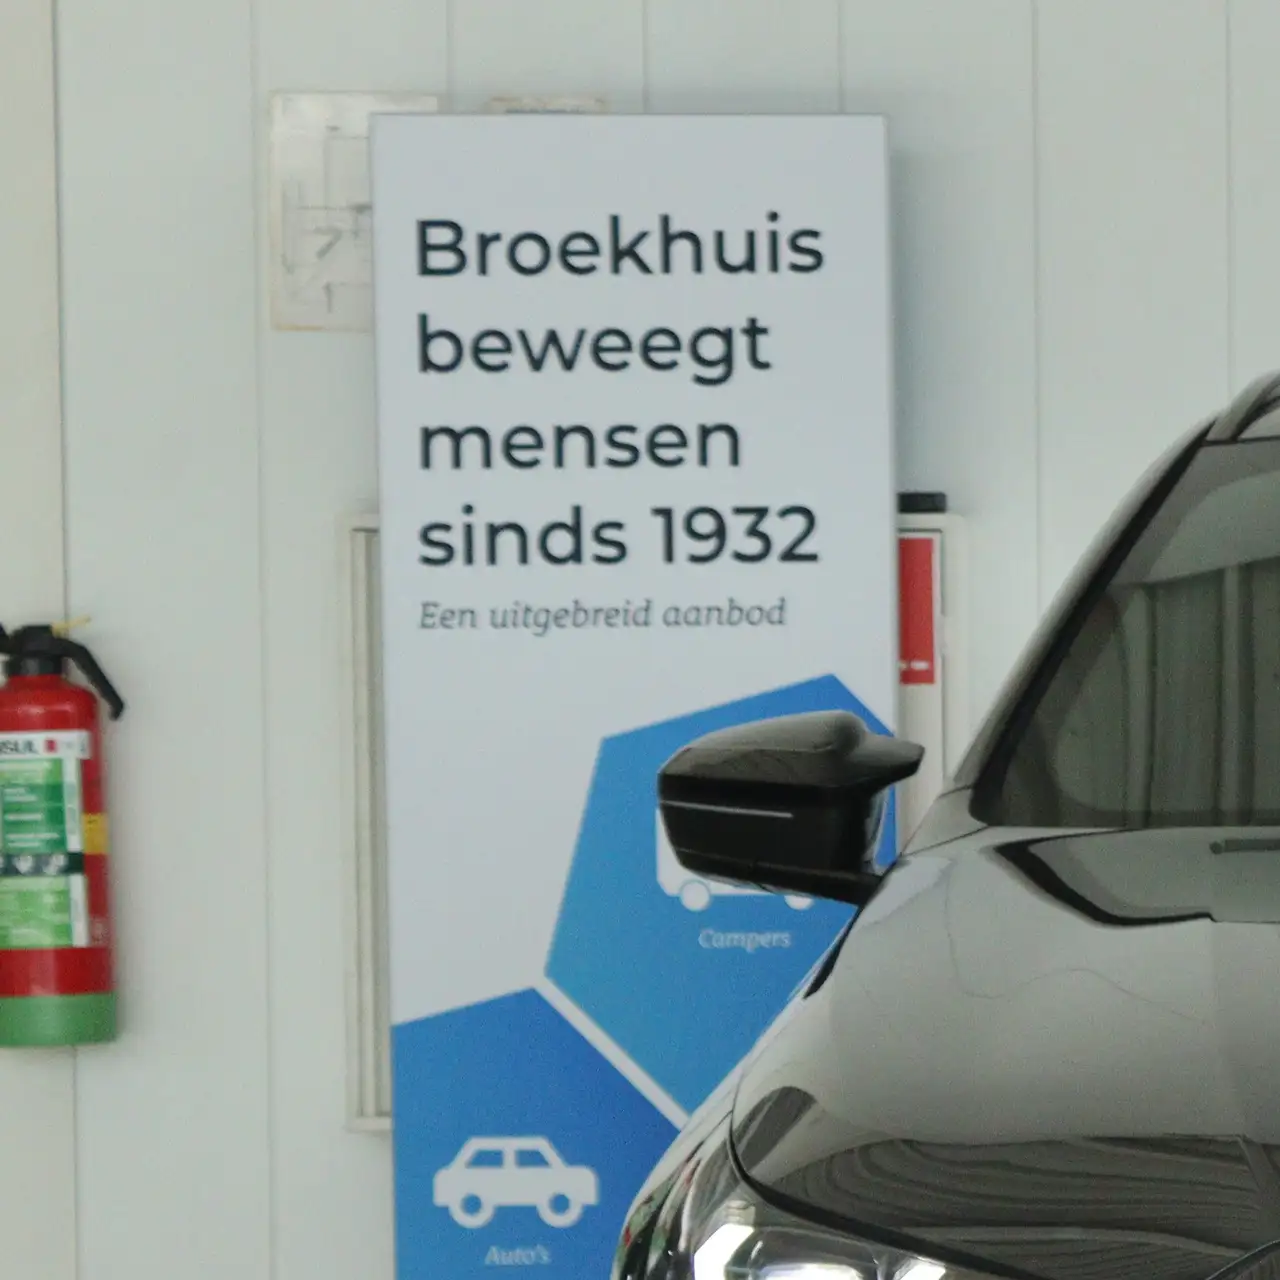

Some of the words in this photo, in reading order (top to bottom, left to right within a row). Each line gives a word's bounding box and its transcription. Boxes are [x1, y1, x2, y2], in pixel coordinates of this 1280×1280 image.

[416, 210, 824, 277] Broekhuis
[418, 313, 772, 387] beweegt
[420, 422, 740, 470] mensen
[419, 504, 628, 567] sinds
[651, 505, 820, 566] 1932
[419, 600, 477, 630] Een
[489, 598, 652, 637] uitgebreid
[662, 596, 787, 628] aanbod
[698, 929, 793, 953] Campers
[483, 1243, 551, 1266] Auto's
